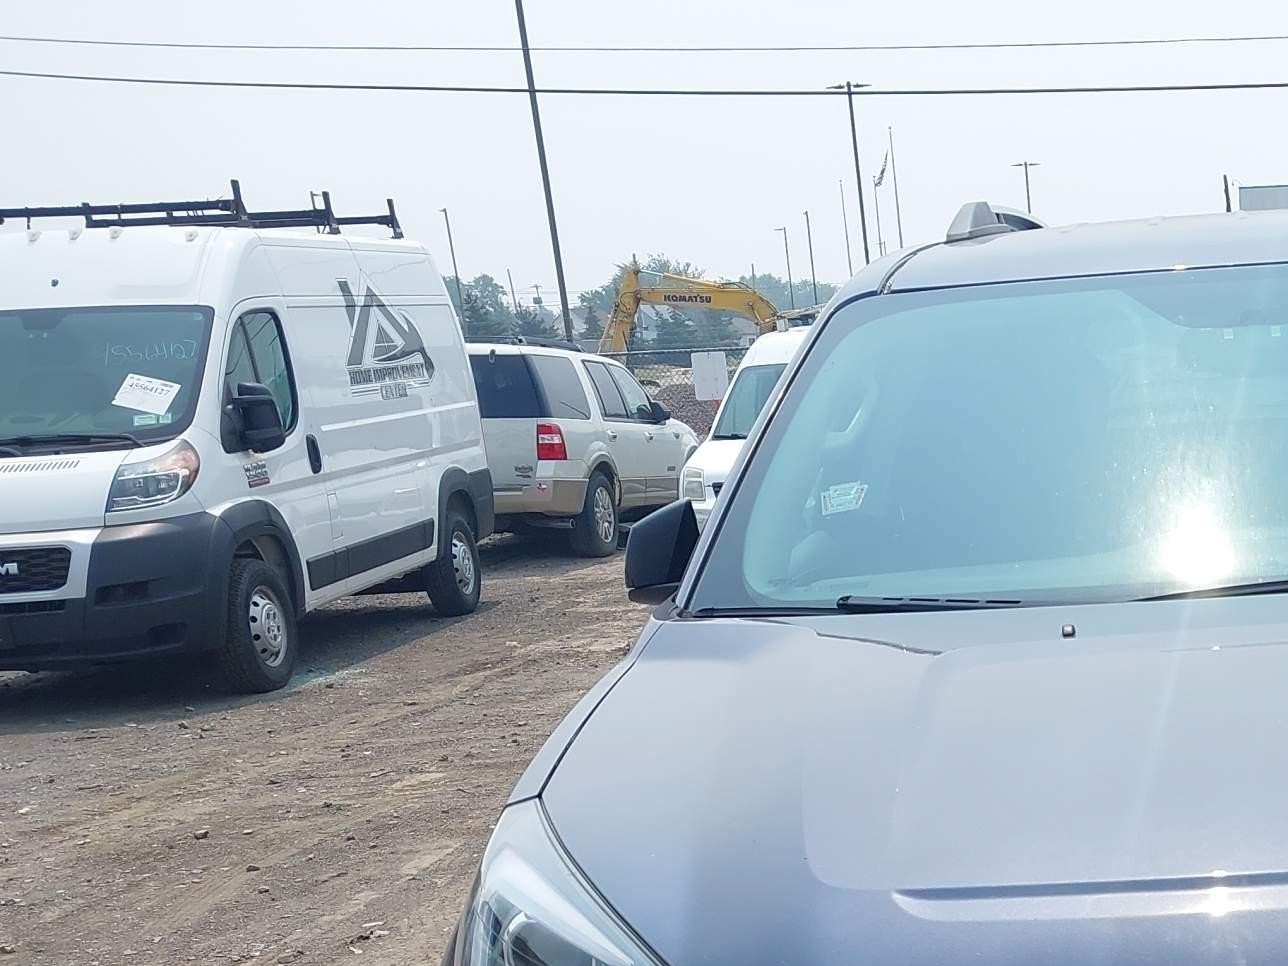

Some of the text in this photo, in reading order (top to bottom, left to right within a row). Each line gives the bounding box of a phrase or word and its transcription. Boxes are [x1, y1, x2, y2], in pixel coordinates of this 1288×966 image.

[663, 294, 712, 304] KOMATSU
[349, 362, 425, 385] HOME IMPROVEMENT
[380, 383, 408, 400] CENTER
